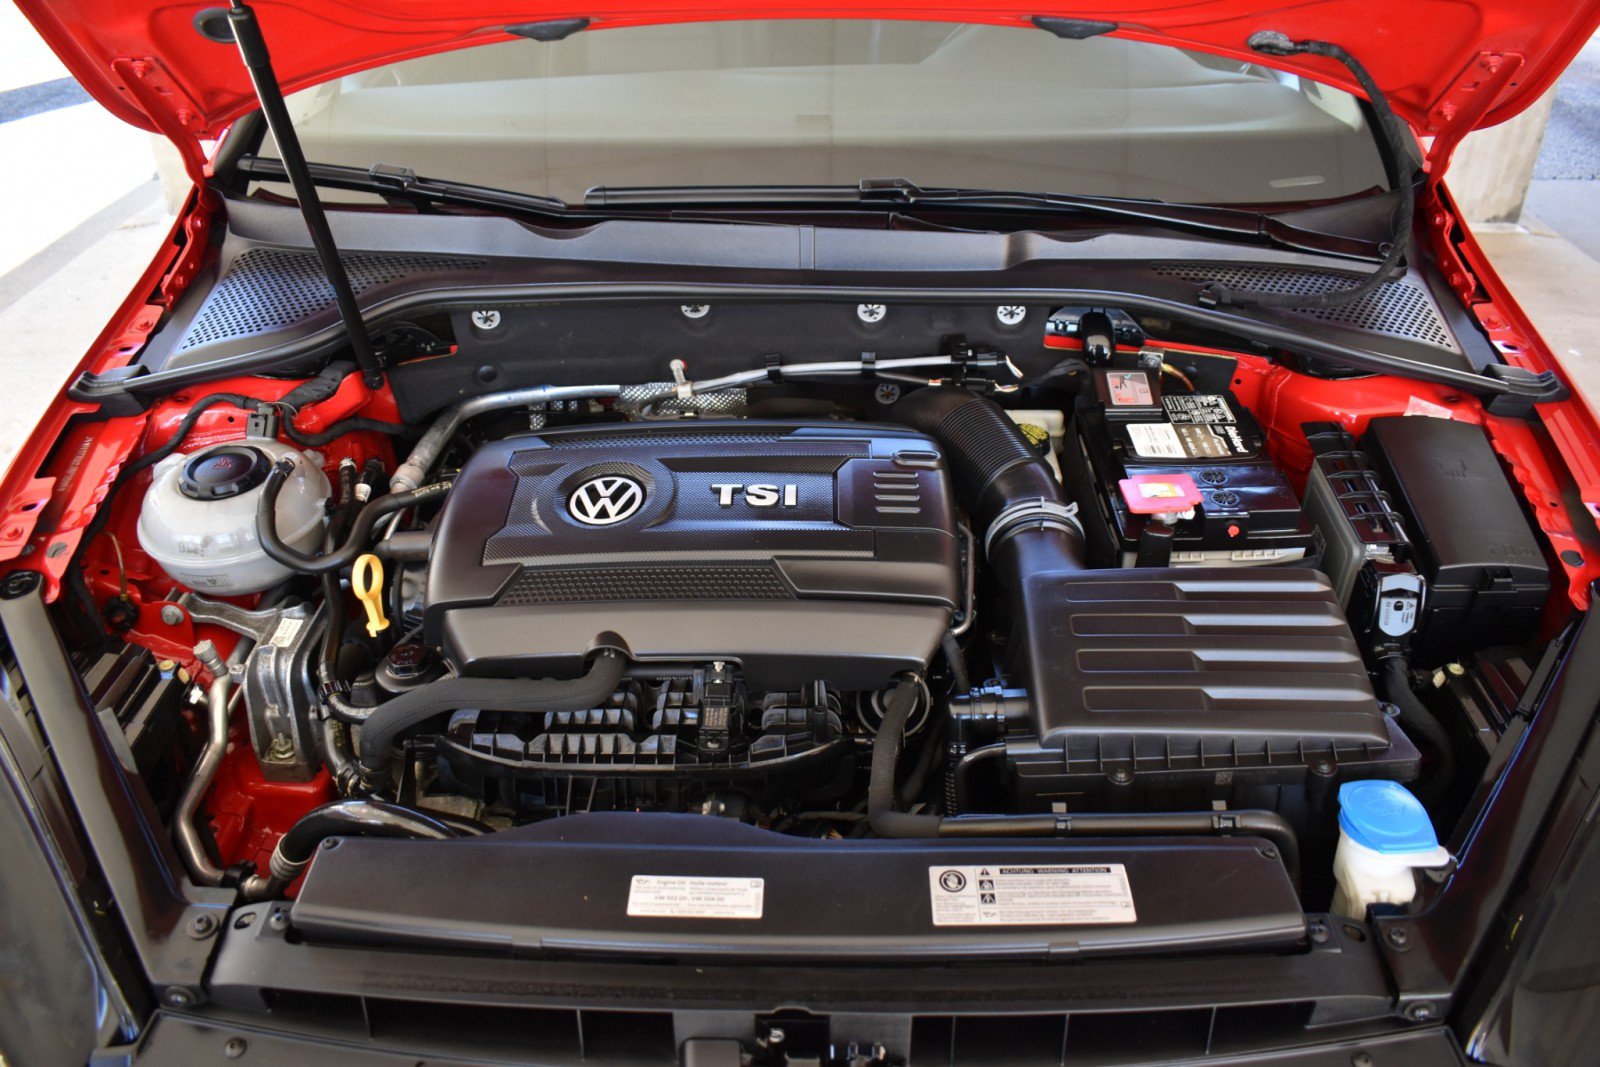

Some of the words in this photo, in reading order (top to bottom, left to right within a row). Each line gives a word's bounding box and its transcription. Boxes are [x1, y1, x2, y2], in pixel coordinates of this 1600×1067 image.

[1224, 425, 1249, 453] DieHard
[569, 476, 644, 526] VW
[711, 483, 797, 507] TSI
